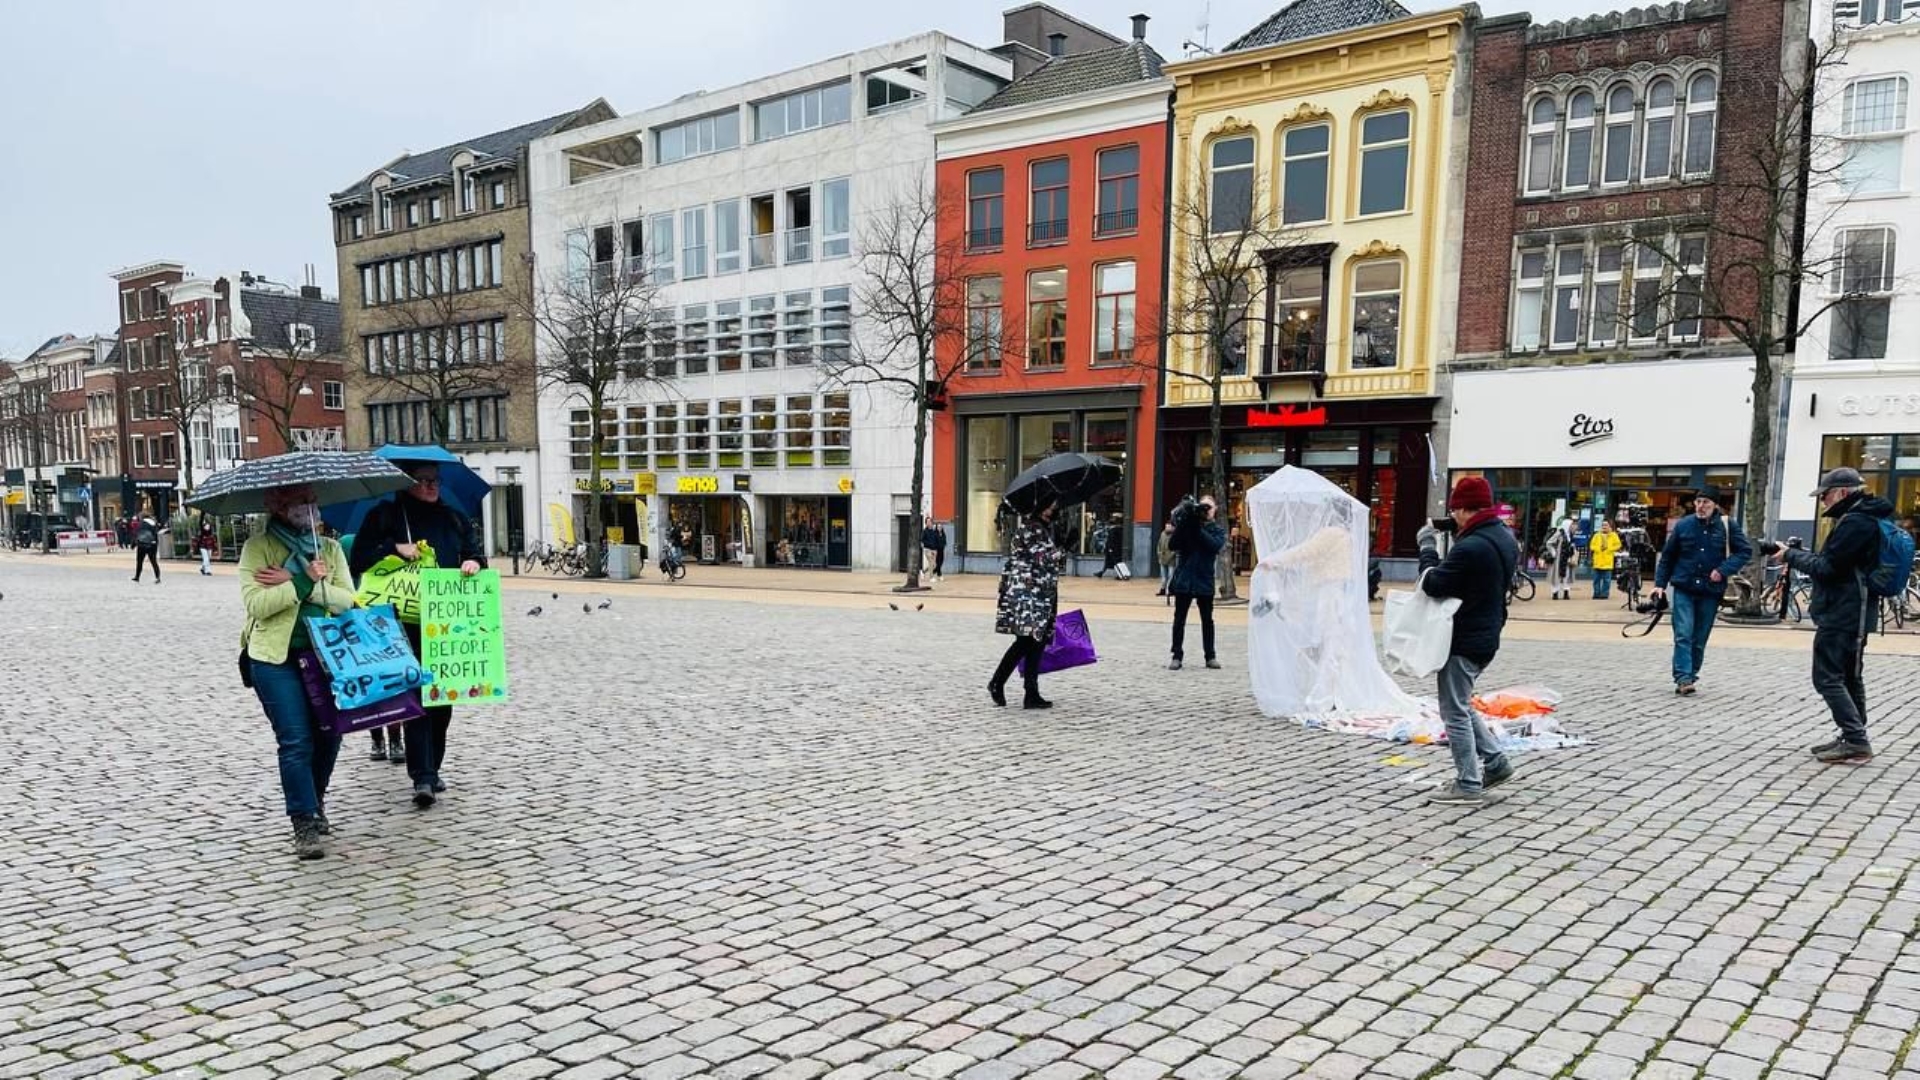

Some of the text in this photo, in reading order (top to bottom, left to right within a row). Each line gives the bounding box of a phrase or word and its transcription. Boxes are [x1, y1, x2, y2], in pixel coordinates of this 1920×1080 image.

[1569, 413, 1613, 438] Etos
[428, 579, 479, 596] PLANET
[428, 601, 485, 618] PEOPLE
[319, 620, 361, 648] DE
[429, 639, 493, 658] BEFORE
[429, 660, 488, 679] PROFIT
